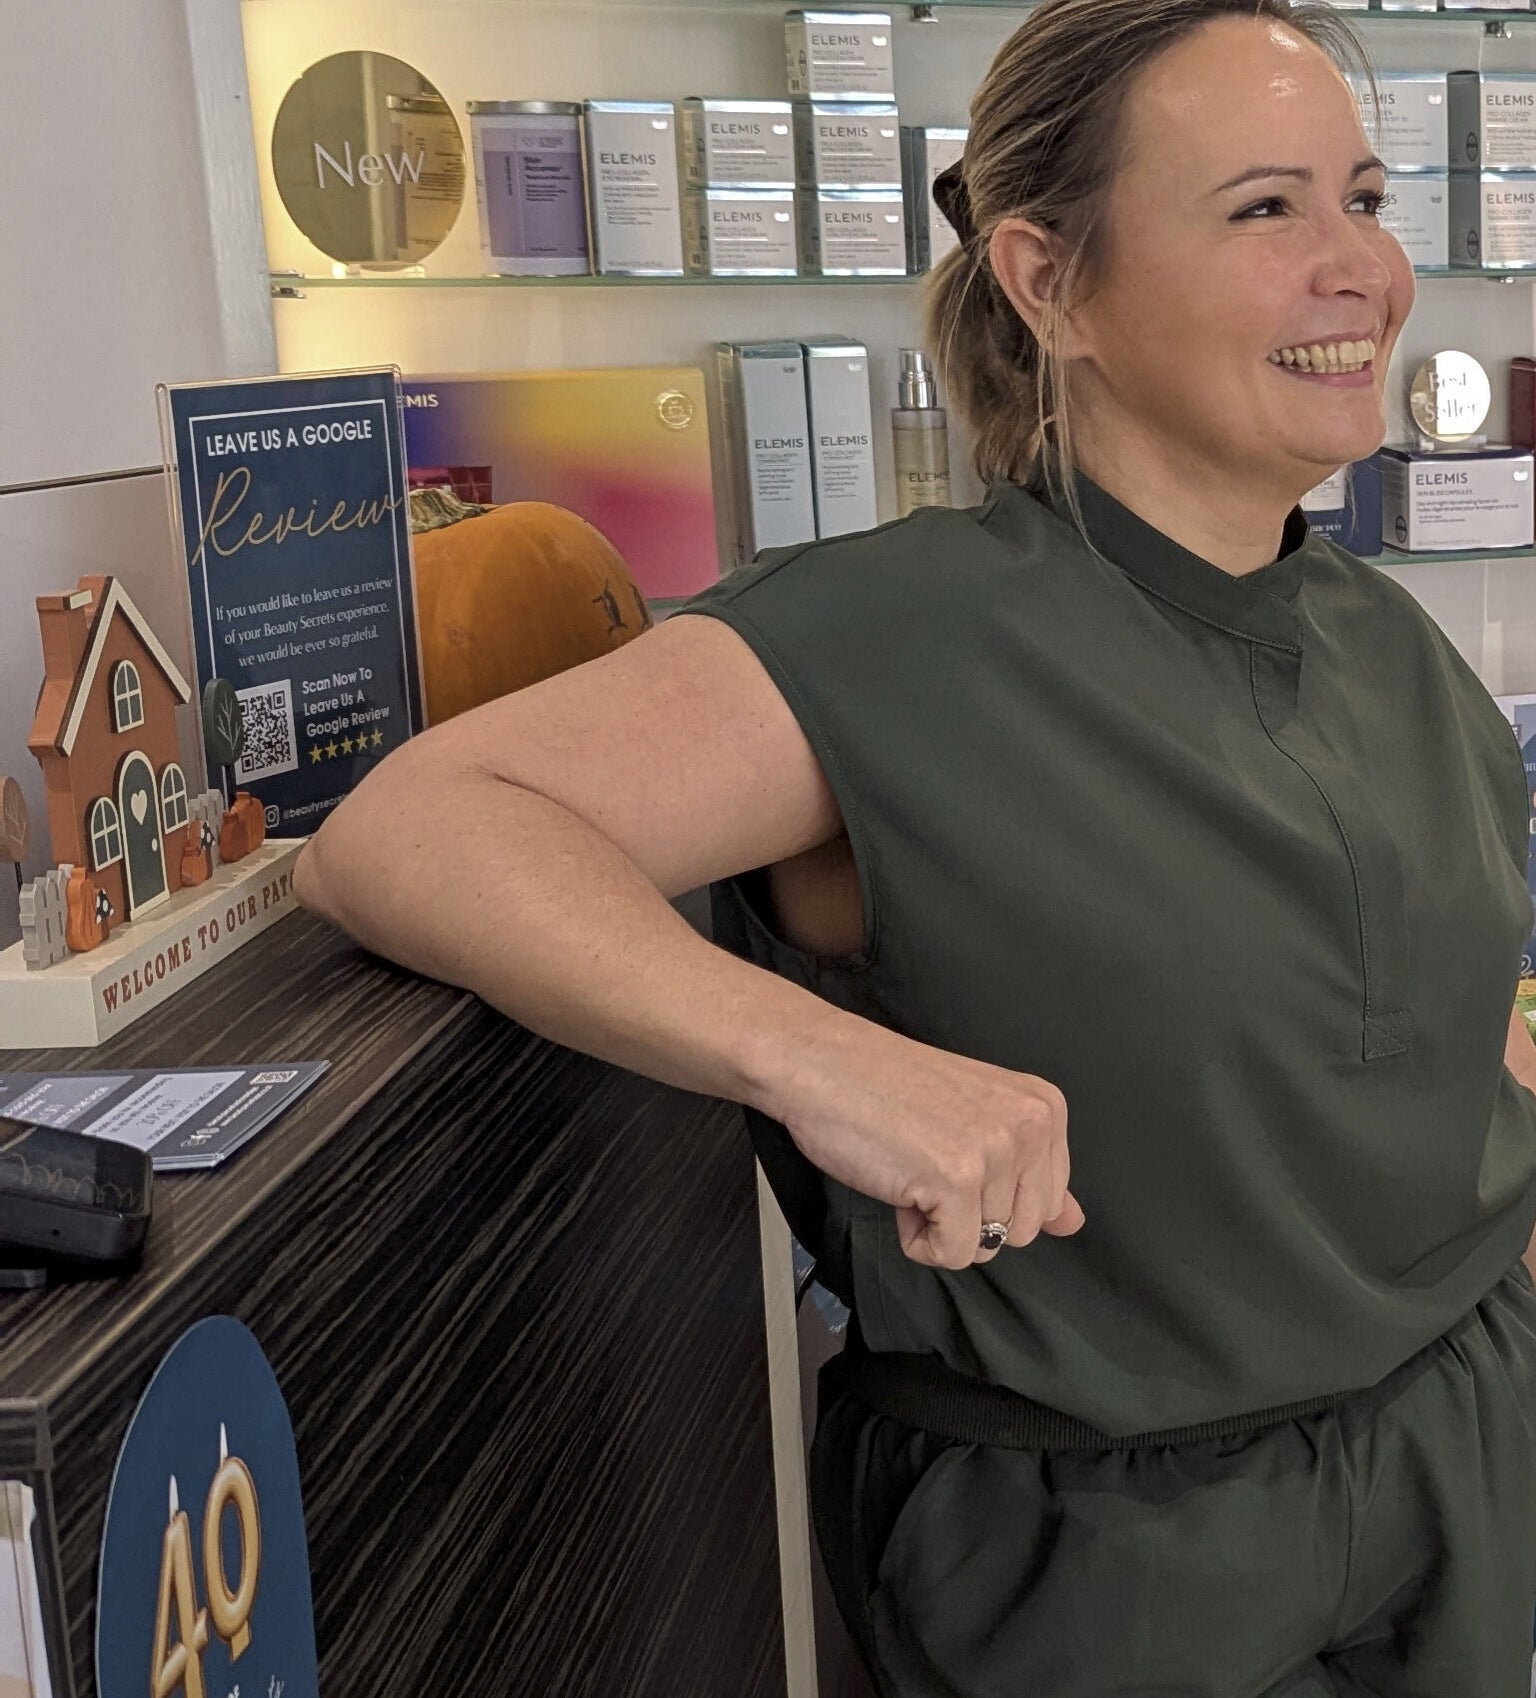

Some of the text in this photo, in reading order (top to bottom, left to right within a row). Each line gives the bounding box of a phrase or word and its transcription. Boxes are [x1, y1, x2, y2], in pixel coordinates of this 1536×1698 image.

[811, 34, 861, 46] ELEMIS
[1486, 94, 1534, 106] ELEMIS
[711, 123, 761, 135] ELEMIS
[820, 126, 869, 138] ELEMIS
[314, 141, 424, 189] New
[600, 153, 657, 165] ELEMIS
[1486, 193, 1535, 205] ELEMIS
[713, 211, 763, 222] ELEMIS
[825, 212, 873, 224] ELEMIS
[206, 418, 373, 457] LEAVE US A GOOGLE
[754, 438, 804, 449] ELEMIS
[820, 435, 869, 446] ELEMIS
[1415, 472, 1468, 485] ELEMIS
[191, 466, 403, 566] Review
[215, 578, 393, 622] If you would like to leave us a review
[224, 602, 391, 645] of your Beauty Secrets experience.
[238, 655, 255, 667] we
[257, 645, 289, 663] would
[290, 642, 303, 656] be
[304, 640, 327, 654] ever
[328, 637, 341, 648] so
[302, 667, 373, 694] Scan Now To
[303, 689, 366, 717] Leave Us A
[306, 706, 390, 737] Google Review
[102, 936, 192, 1014] WELCOME
[198, 918, 220, 950] TO
[226, 895, 257, 933] OUR
